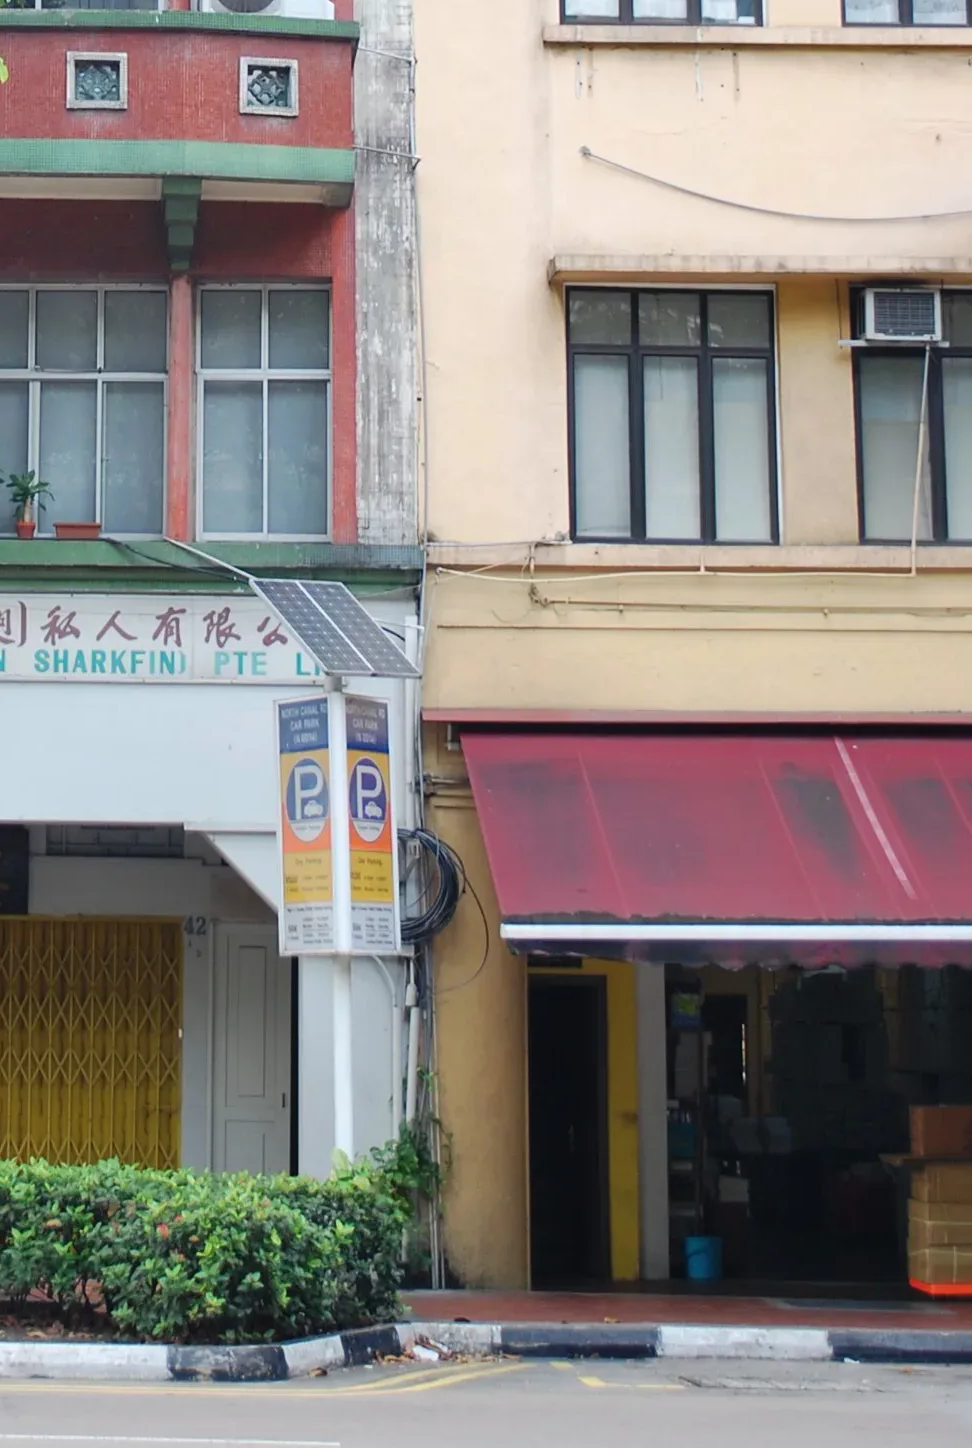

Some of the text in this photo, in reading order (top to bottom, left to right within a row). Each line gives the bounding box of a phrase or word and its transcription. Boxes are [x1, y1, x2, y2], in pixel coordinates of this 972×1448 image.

[34, 648, 187, 676] SHARKFIN)
[215, 650, 266, 676] PTE
[184, 915, 207, 936] 42
